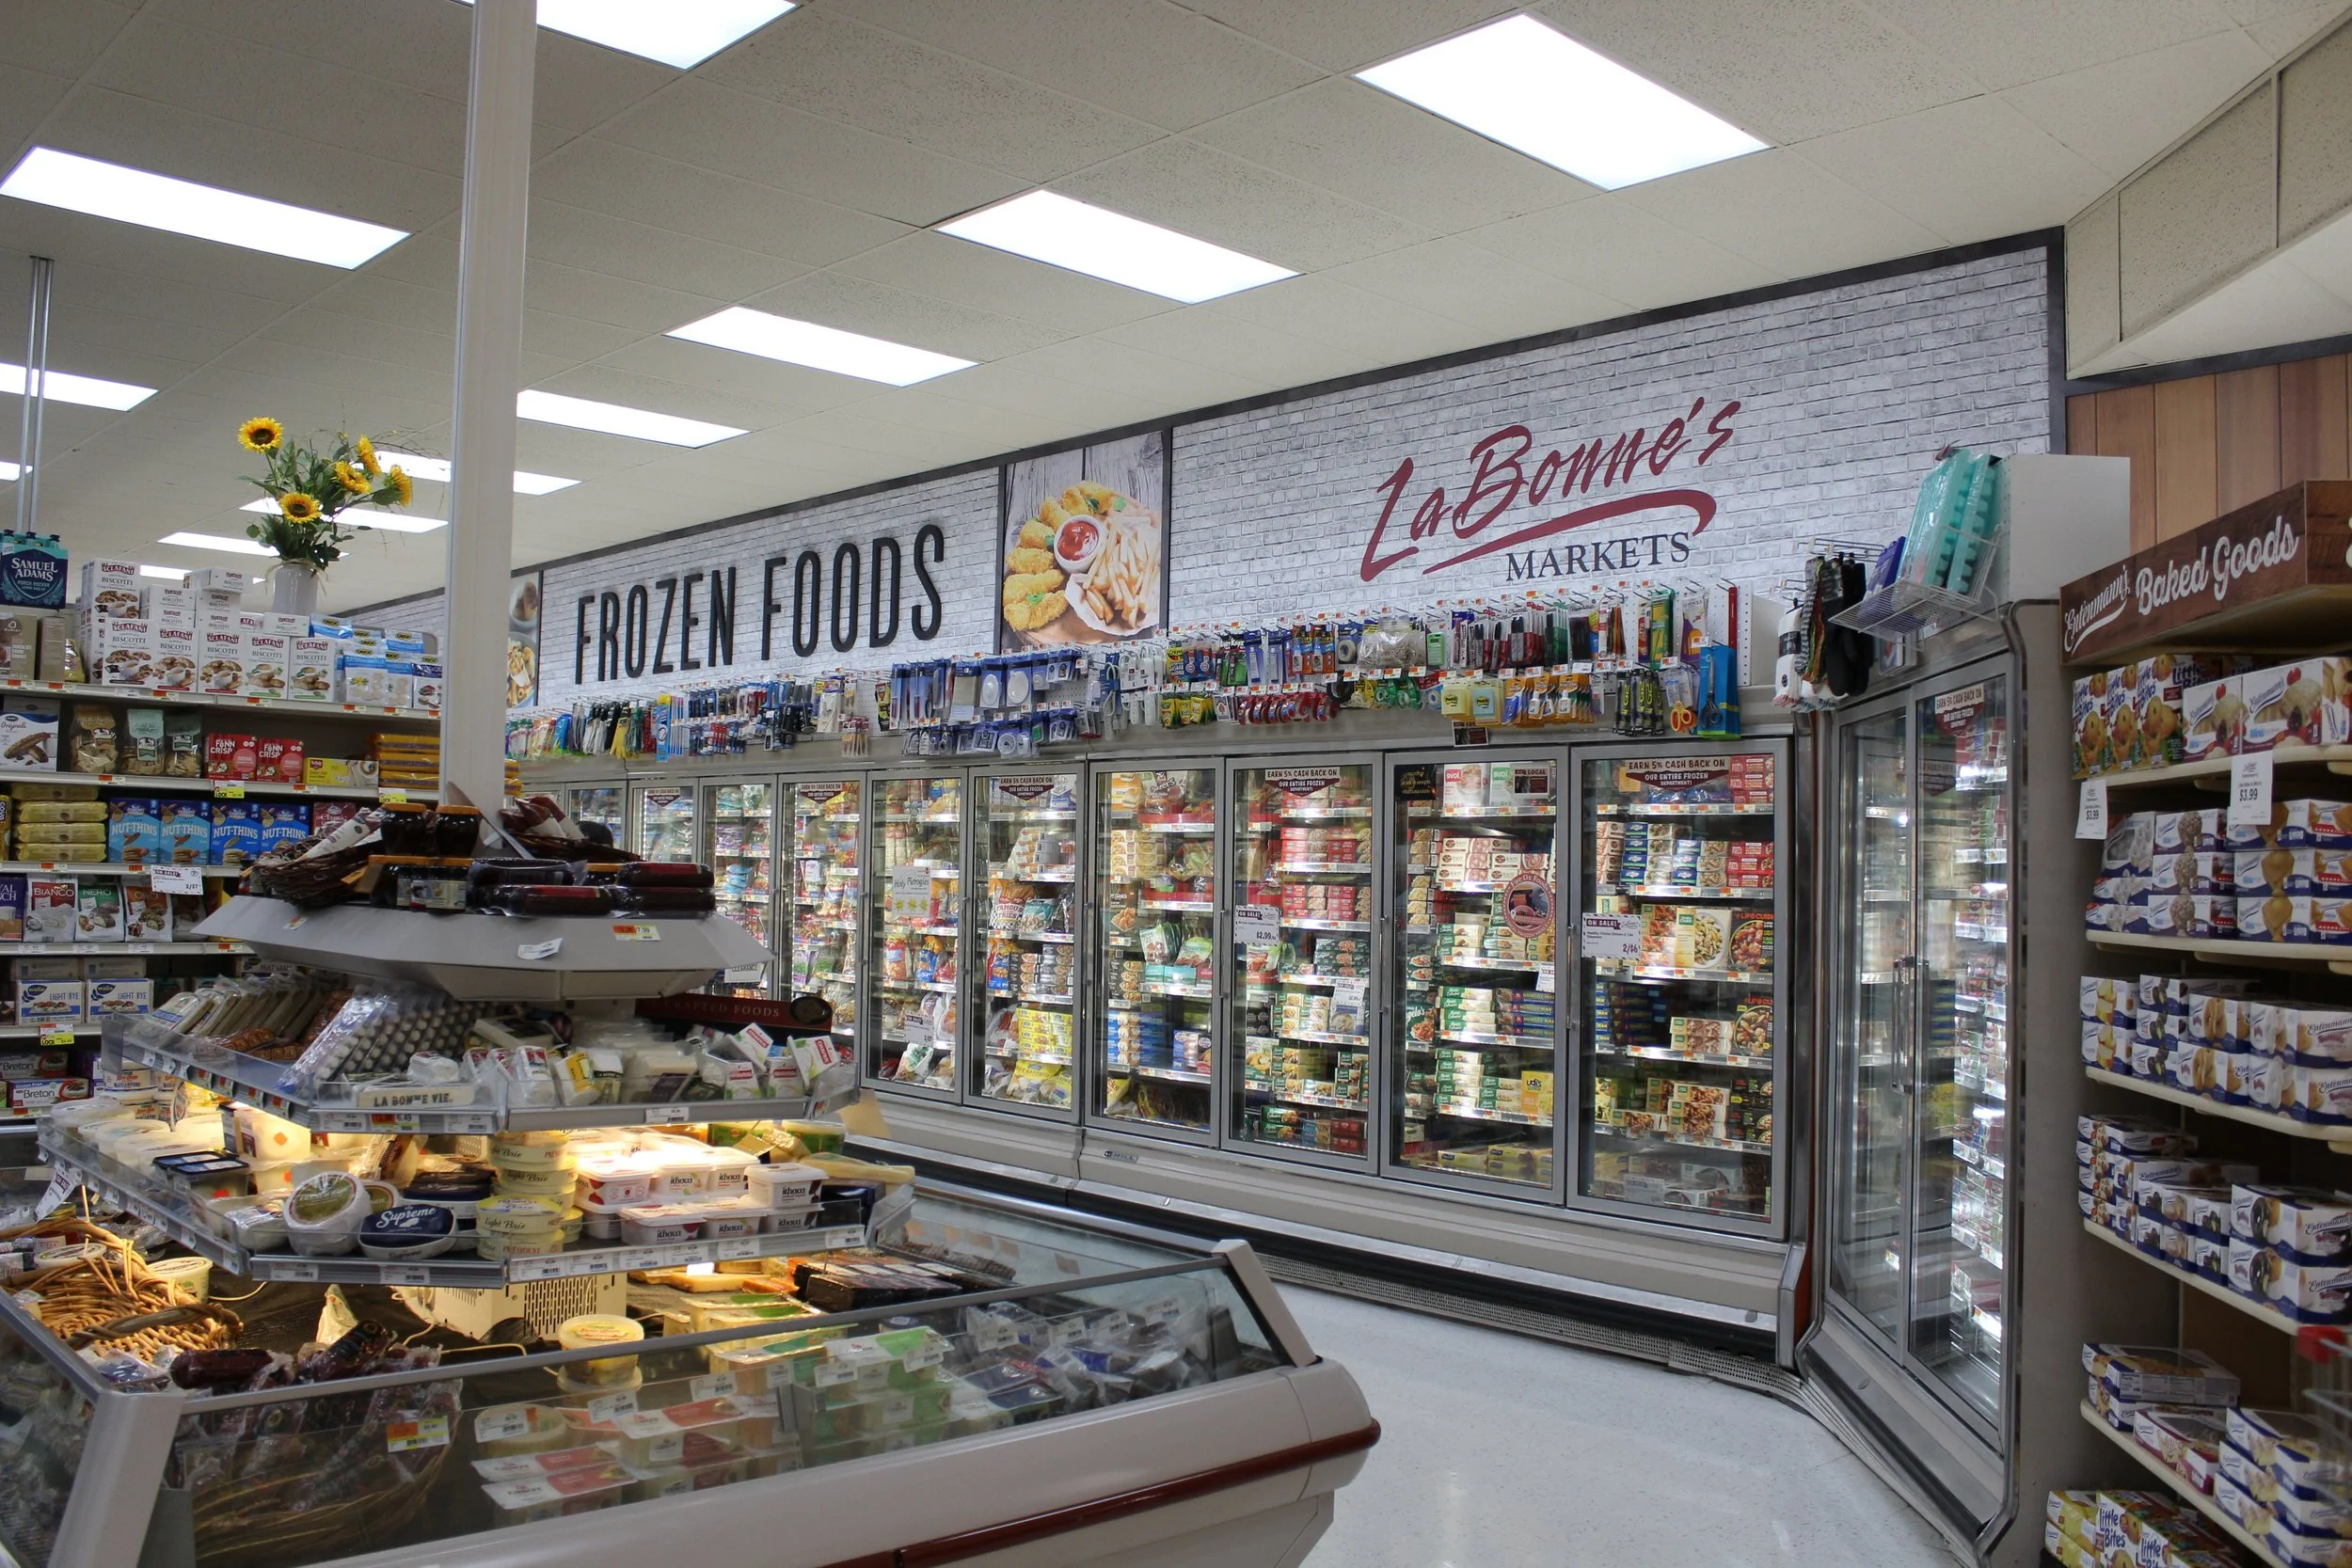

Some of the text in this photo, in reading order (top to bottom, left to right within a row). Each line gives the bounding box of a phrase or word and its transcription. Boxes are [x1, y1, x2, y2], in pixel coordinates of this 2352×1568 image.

[1506, 532, 1691, 581] MARKETS
[12, 558, 58, 573] SAMUEL
[15, 566, 54, 581] ADAMS
[102, 578, 133, 586] BISCOTTI
[2064, 515, 2298, 652] Entenmann's Baked Goods
[575, 524, 945, 685] FROZEN FOODS
[252, 650, 282, 658] BISCOTTI
[2172, 663, 2203, 685] Little
[1623, 684, 1630, 705] G2
[1638, 680, 1645, 702] G2
[1645, 683, 1653, 705] G2
[211, 746, 232, 754] CRISP
[215, 739, 235, 749] FINN
[263, 744, 282, 752] FINN
[259, 750, 280, 758] CRISP
[1629, 761, 1649, 769] EARN
[1666, 760, 1687, 768] CASH
[2239, 788, 2258, 801] $3.99
[2086, 810, 2099, 820] $3.99
[111, 822, 158, 836] NUT-THINS
[162, 823, 208, 838] NUT-THINS
[213, 825, 259, 839] NUT-THINS
[262, 827, 306, 840] NUT-THINS
[894, 877, 929, 889] Holy Pierogies
[35, 888, 74, 897] BIANCO
[135, 892, 158, 900] ORO
[1257, 931, 1271, 940] $2.99
[1623, 943, 1638, 954] 2/$6
[734, 1006, 779, 1018] FOODS
[2307, 1011, 2352, 1034] Entenmann
[2318, 1075, 2352, 1095] Entenma
[24, 1089, 55, 1099] Breton
[373, 1097, 388, 1107] LA
[376, 1207, 437, 1228] Supreme
[2306, 1216, 2352, 1234] Entenmann
[2309, 1275, 2352, 1291] Entenmann
[2099, 1508, 2120, 1527] Little
[2104, 1530, 2125, 1548] Bites
[2141, 1538, 2163, 1559] Little
